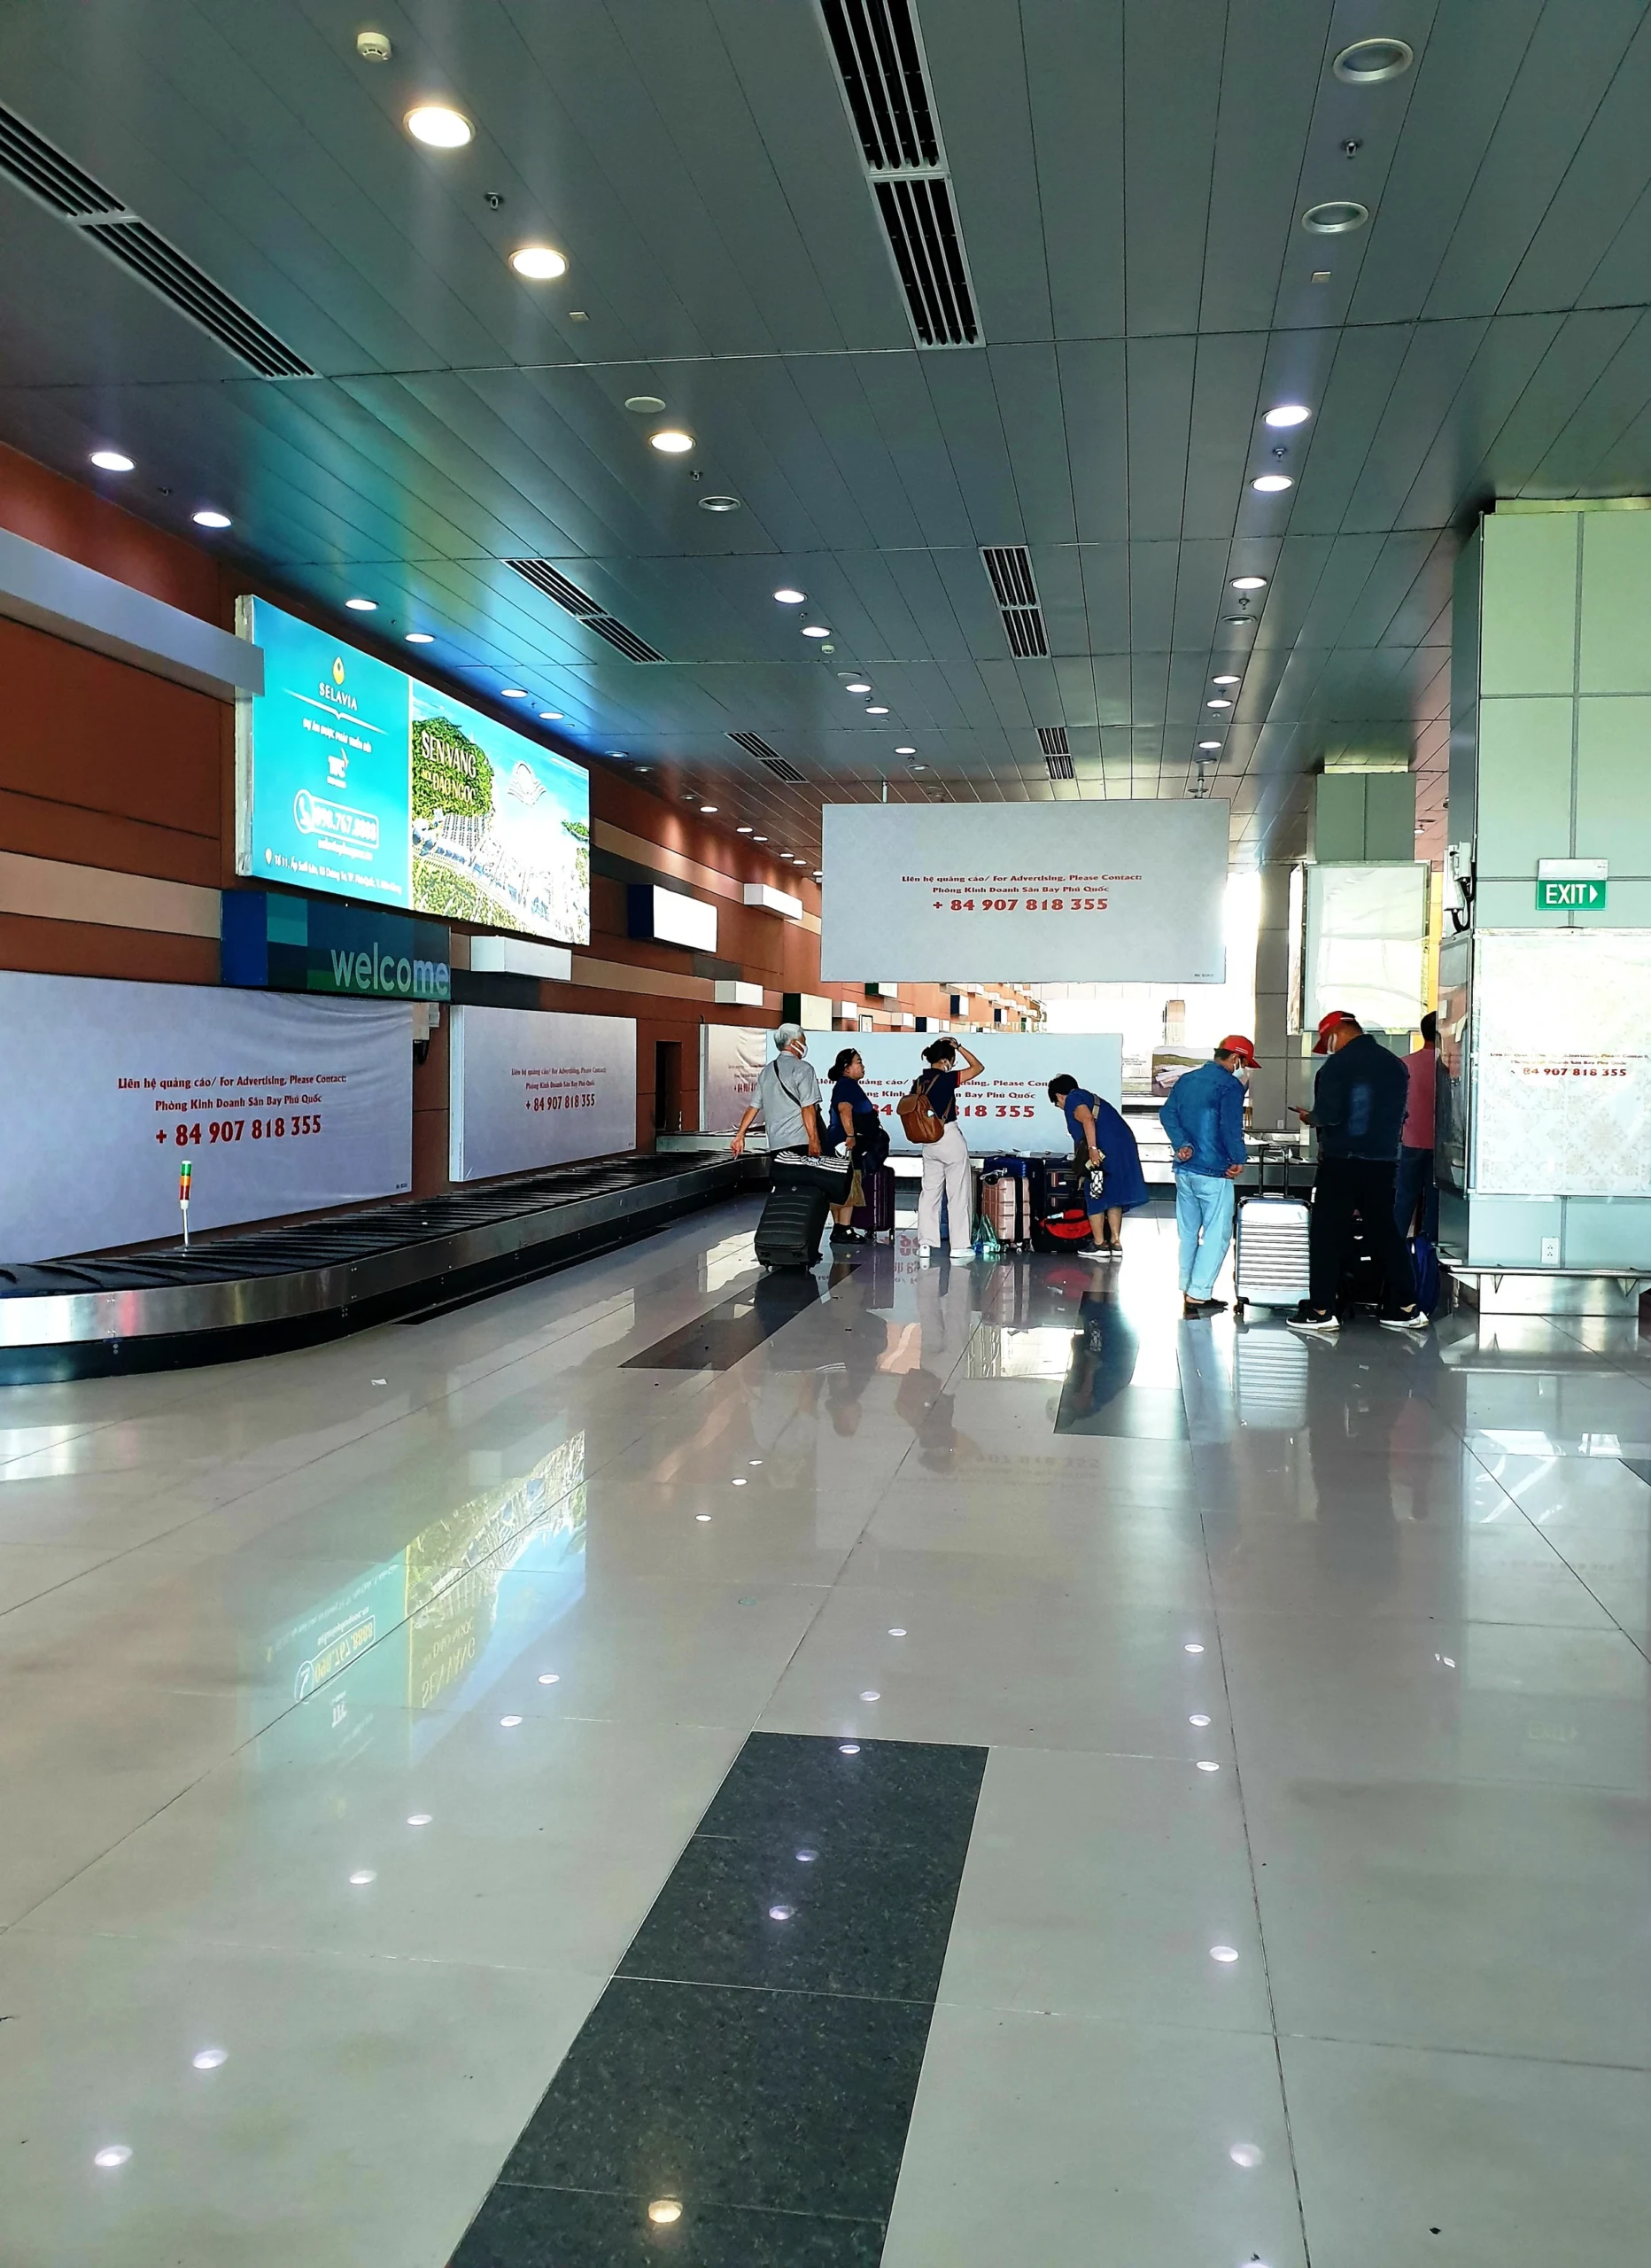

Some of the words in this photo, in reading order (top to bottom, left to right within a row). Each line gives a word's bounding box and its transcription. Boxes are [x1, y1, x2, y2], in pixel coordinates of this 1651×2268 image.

[319, 681, 358, 711] SELAVIA
[422, 729, 445, 766] SEN
[1546, 884, 1587, 904] EXIT
[950, 899, 975, 911] 84
[981, 899, 1019, 911] 907
[1026, 898, 1064, 911] 818
[1070, 898, 1108, 910] 355
[330, 942, 450, 995] welcome
[118, 1078, 140, 1089] Liên
[143, 1077, 157, 1090] hệ
[159, 1077, 191, 1090] quảng
[220, 1076, 234, 1086] For
[236, 1076, 287, 1086] Advertising,
[290, 1075, 314, 1084] Please
[315, 1075, 346, 1084] Contact:
[190, 1099, 213, 1109] Kinh
[216, 1098, 245, 1108] Doanh
[267, 1096, 282, 1107] Bay
[533, 1098, 545, 1112] 84
[547, 1096, 562, 1110] 907
[564, 1095, 579, 1109] 818
[581, 1093, 595, 1107] 355
[996, 1105, 1035, 1118] 355
[156, 1130, 167, 1144] +
[175, 1123, 202, 1146] 84
[209, 1120, 245, 1144] 907
[251, 1118, 285, 1139] 818
[291, 1115, 322, 1136] 355
